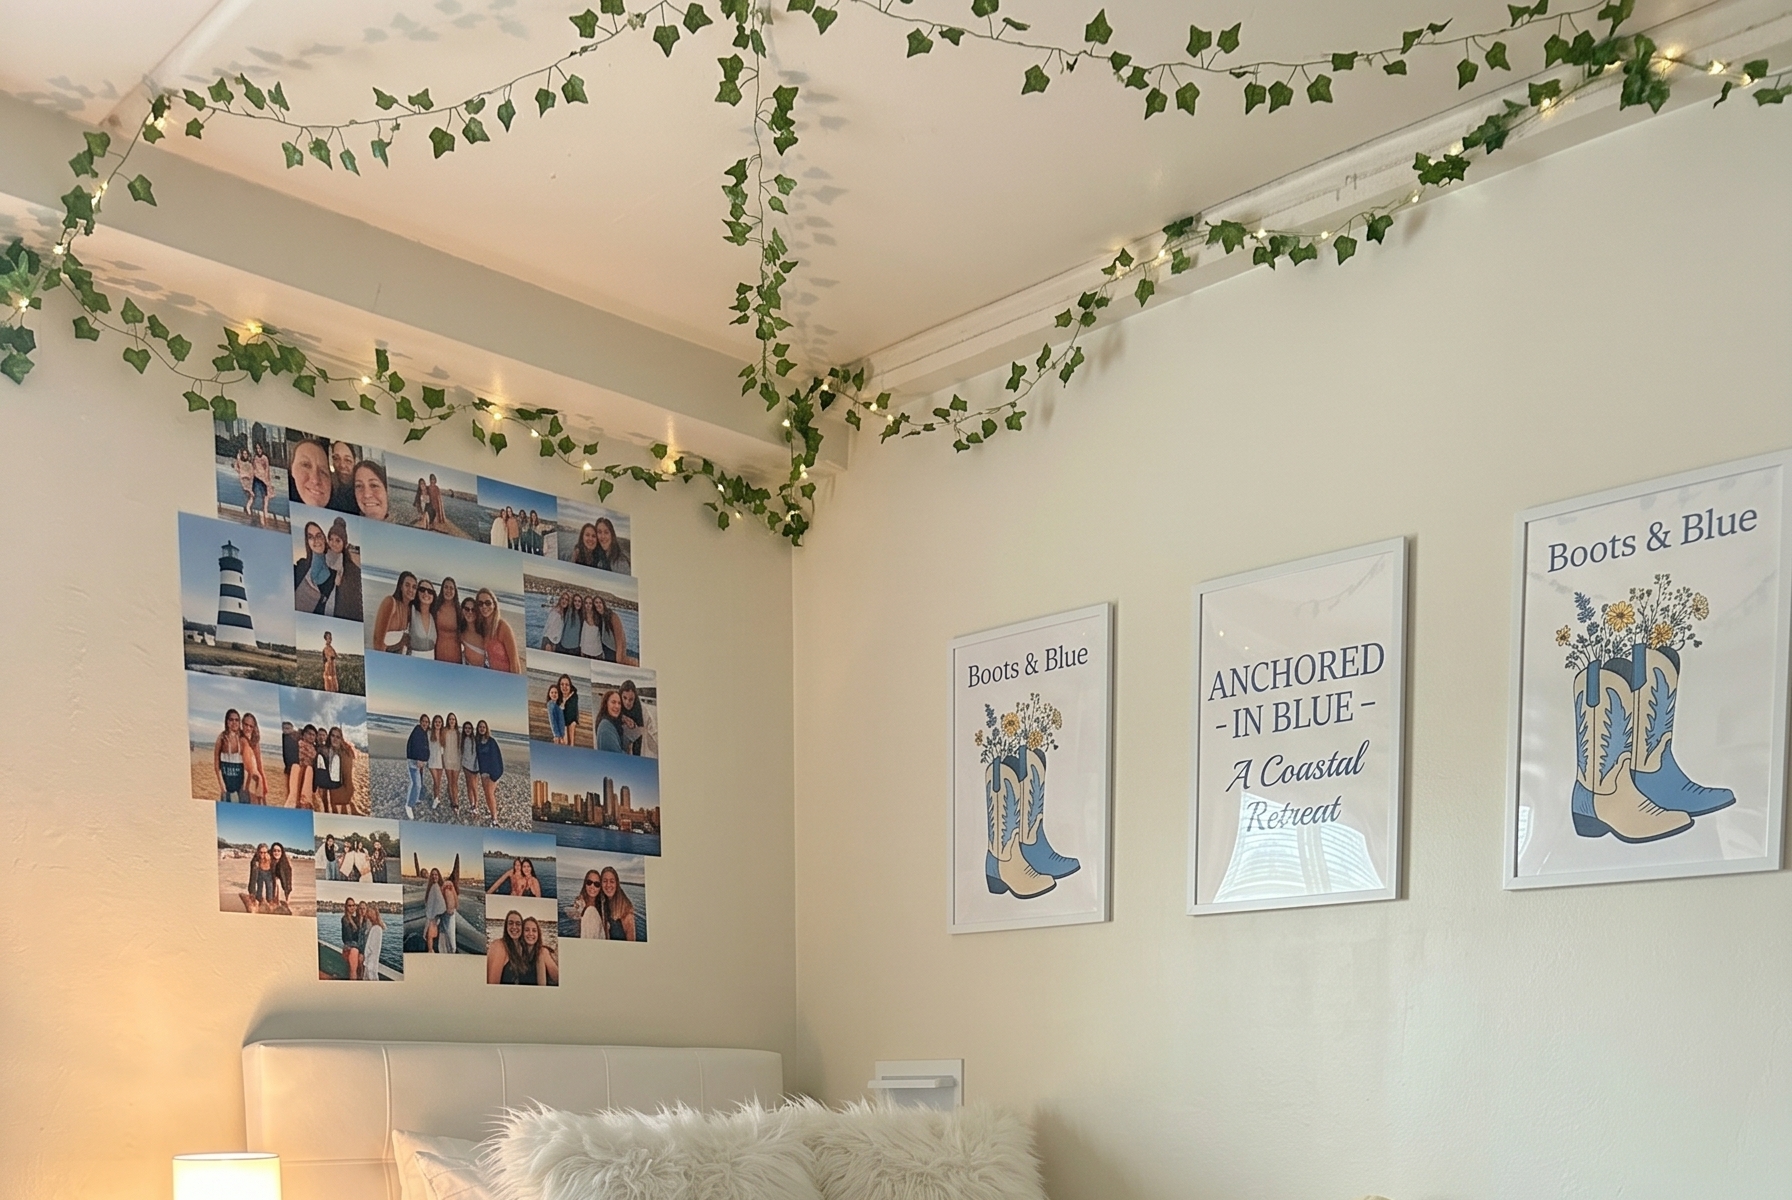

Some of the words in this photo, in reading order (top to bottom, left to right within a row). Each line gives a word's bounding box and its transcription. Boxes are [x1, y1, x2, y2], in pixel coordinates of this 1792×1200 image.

[1547, 533, 1637, 573] Boots
[1646, 520, 1672, 552] &
[1680, 507, 1758, 546] Blue
[967, 658, 1020, 688] Boots
[1024, 652, 1039, 676] &
[1045, 645, 1089, 674] Blue
[1207, 642, 1386, 702] ANCHORED
[1225, 758, 1254, 792] A
[1260, 739, 1371, 788] Coastal
[1246, 795, 1343, 833] Retreat
